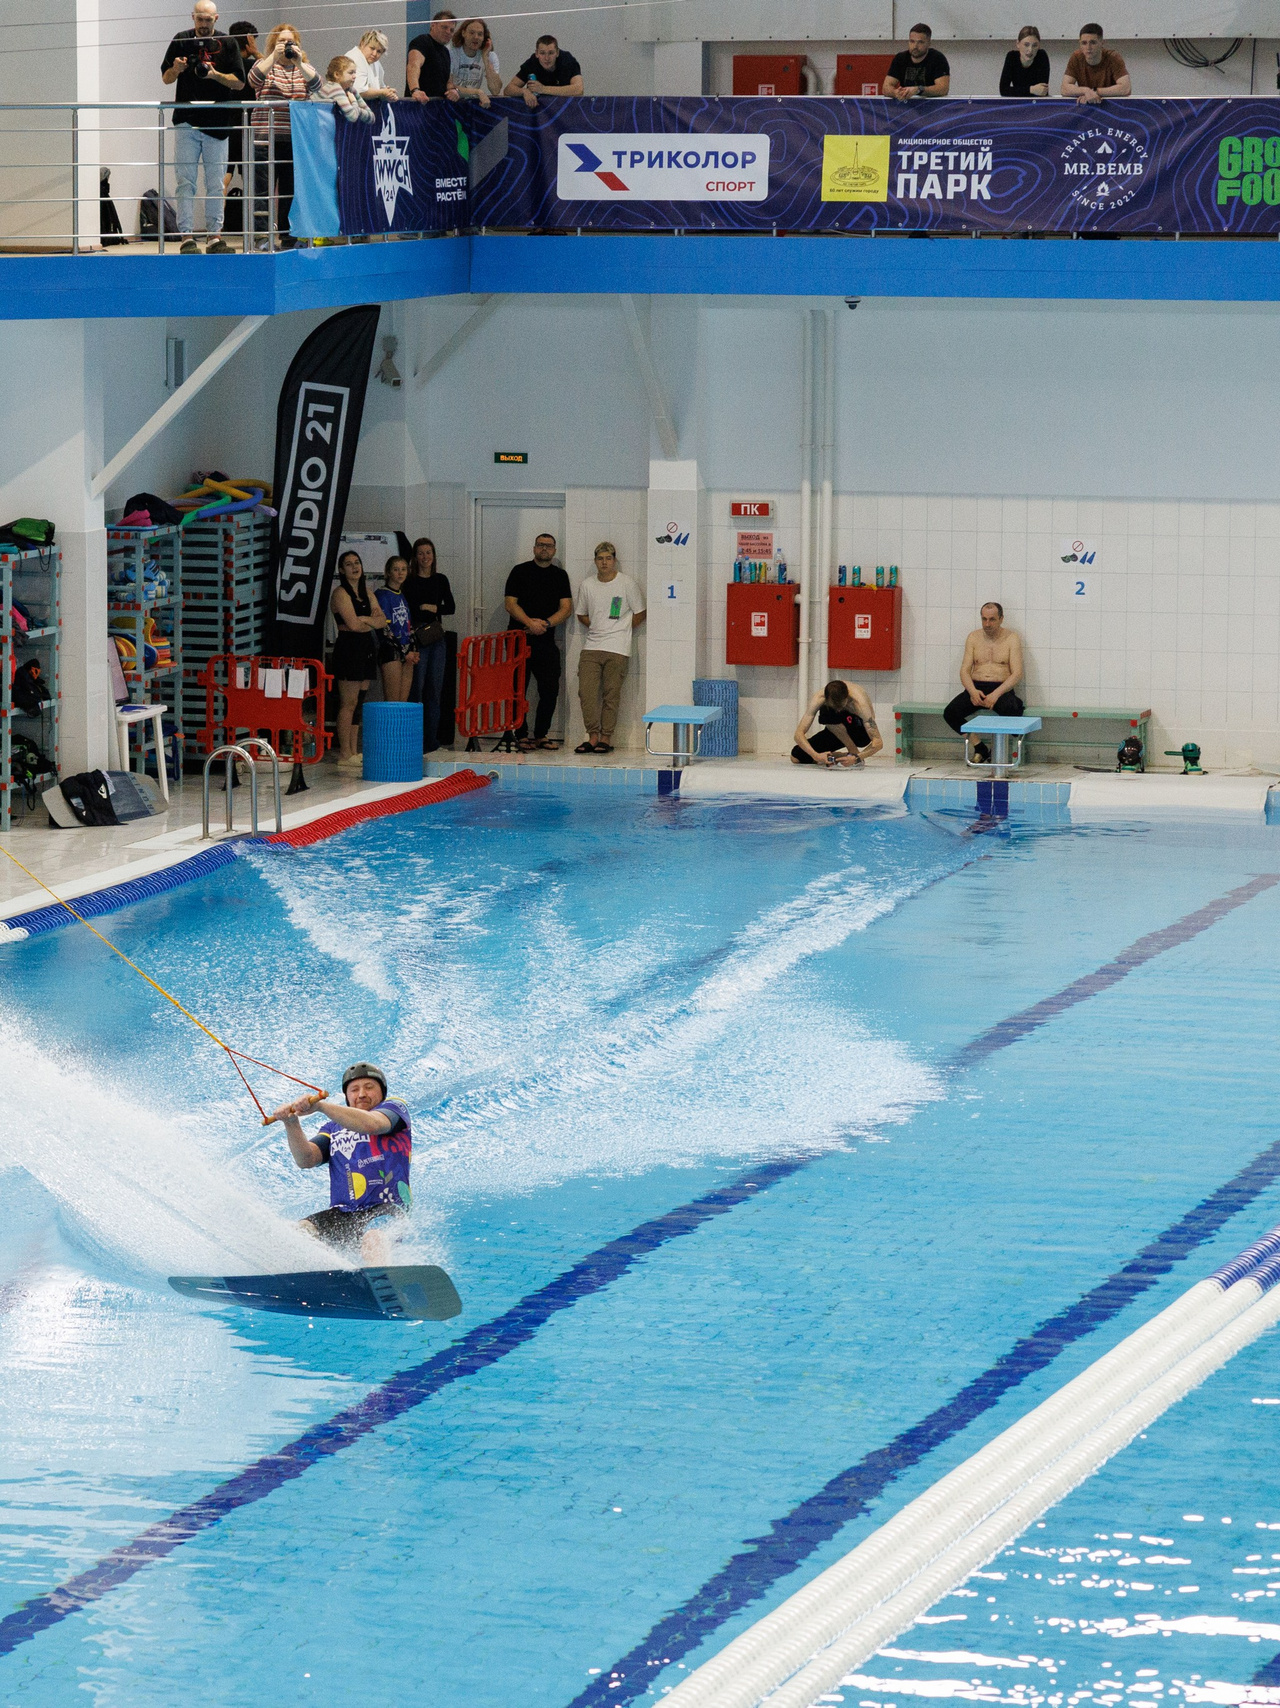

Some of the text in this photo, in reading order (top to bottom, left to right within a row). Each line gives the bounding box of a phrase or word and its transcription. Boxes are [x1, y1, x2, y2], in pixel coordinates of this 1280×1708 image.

[898, 138, 993, 146] АКЦИОНЕРНОЕ ОБЩЕСТВО
[1061, 127, 1148, 159] TRAVEL ENERGY
[612, 150, 757, 169] ТРИКОЛОР
[897, 146, 993, 171] ТРЕТИЙ
[1063, 162, 1143, 175] MR.BEMB
[705, 181, 756, 192] СПОРТ
[896, 173, 992, 200] ПАРК
[1071, 190, 1136, 210] SINCE 2022
[500, 455, 523, 463] ВЫХОД
[280, 402, 335, 602] STUDIO 21
[740, 504, 760, 515] ПК
[667, 585, 677, 599] 1
[1075, 581, 1086, 595] 2
